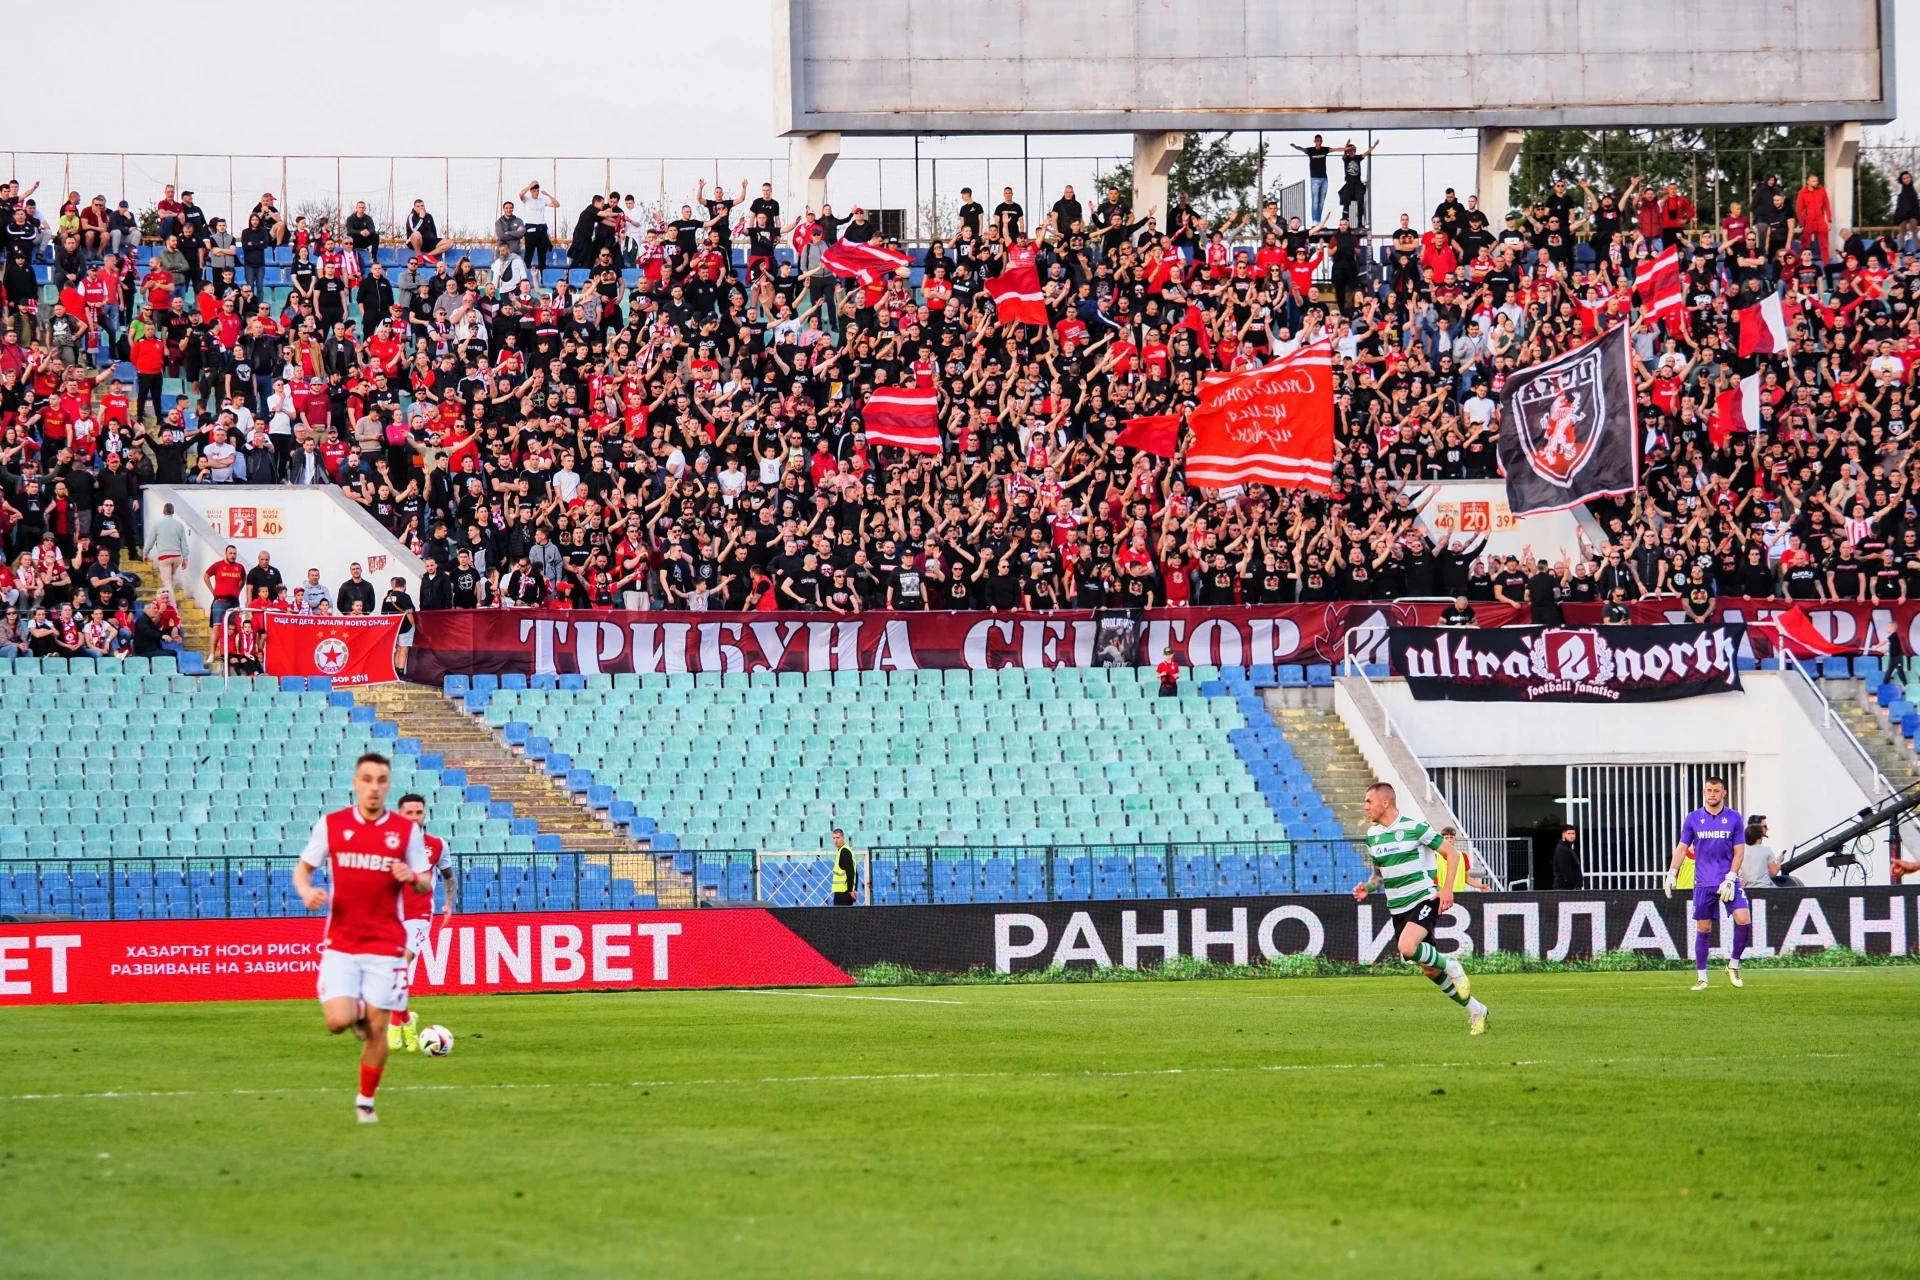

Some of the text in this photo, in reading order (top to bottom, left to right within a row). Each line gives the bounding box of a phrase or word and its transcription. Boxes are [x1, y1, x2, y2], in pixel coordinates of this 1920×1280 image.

[233, 519, 253, 537] 21
[263, 522, 277, 535] 40
[1440, 517, 1454, 529] 40
[1463, 511, 1487, 530] 20
[1496, 515, 1510, 527] 39
[520, 620, 918, 673] ТРИБУНА
[1614, 627, 1735, 685] north
[1527, 680, 1620, 700] football fanatics
[1697, 831, 1731, 839] WINBET
[1420, 905, 1432, 918] 8
[994, 896, 1920, 975] РАННО ИЗПЛАЩАН
[126, 945, 211, 958] ХАЗАРТЪТ
[216, 944, 263, 957] НОСИ
[267, 943, 311, 955] РИСК
[407, 923, 682, 986] WINBET
[111, 962, 211, 975] РАЗВИВАНЕ
[216, 961, 240, 974] НА
